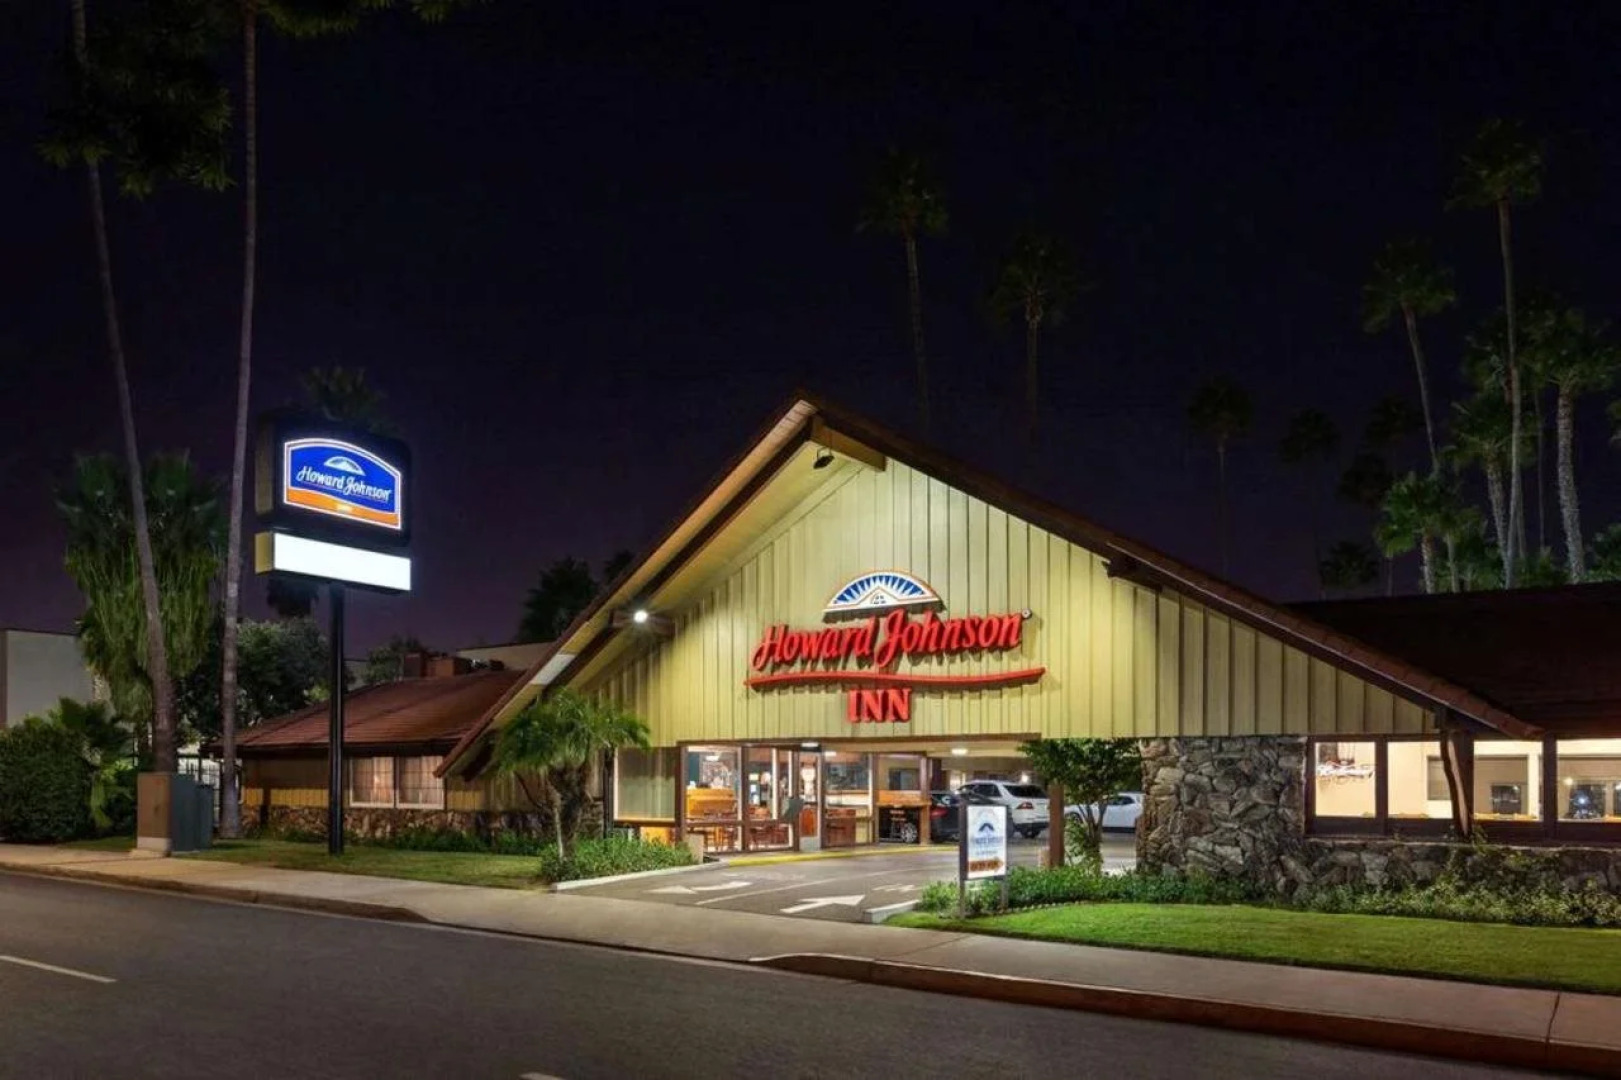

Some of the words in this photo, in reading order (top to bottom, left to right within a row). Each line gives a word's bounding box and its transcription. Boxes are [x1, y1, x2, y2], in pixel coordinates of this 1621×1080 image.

[296, 466, 344, 489] Howard
[343, 476, 391, 501] Johnson
[751, 617, 880, 670] Howard
[876, 608, 1023, 668] Johnson
[847, 688, 911, 723] INN
